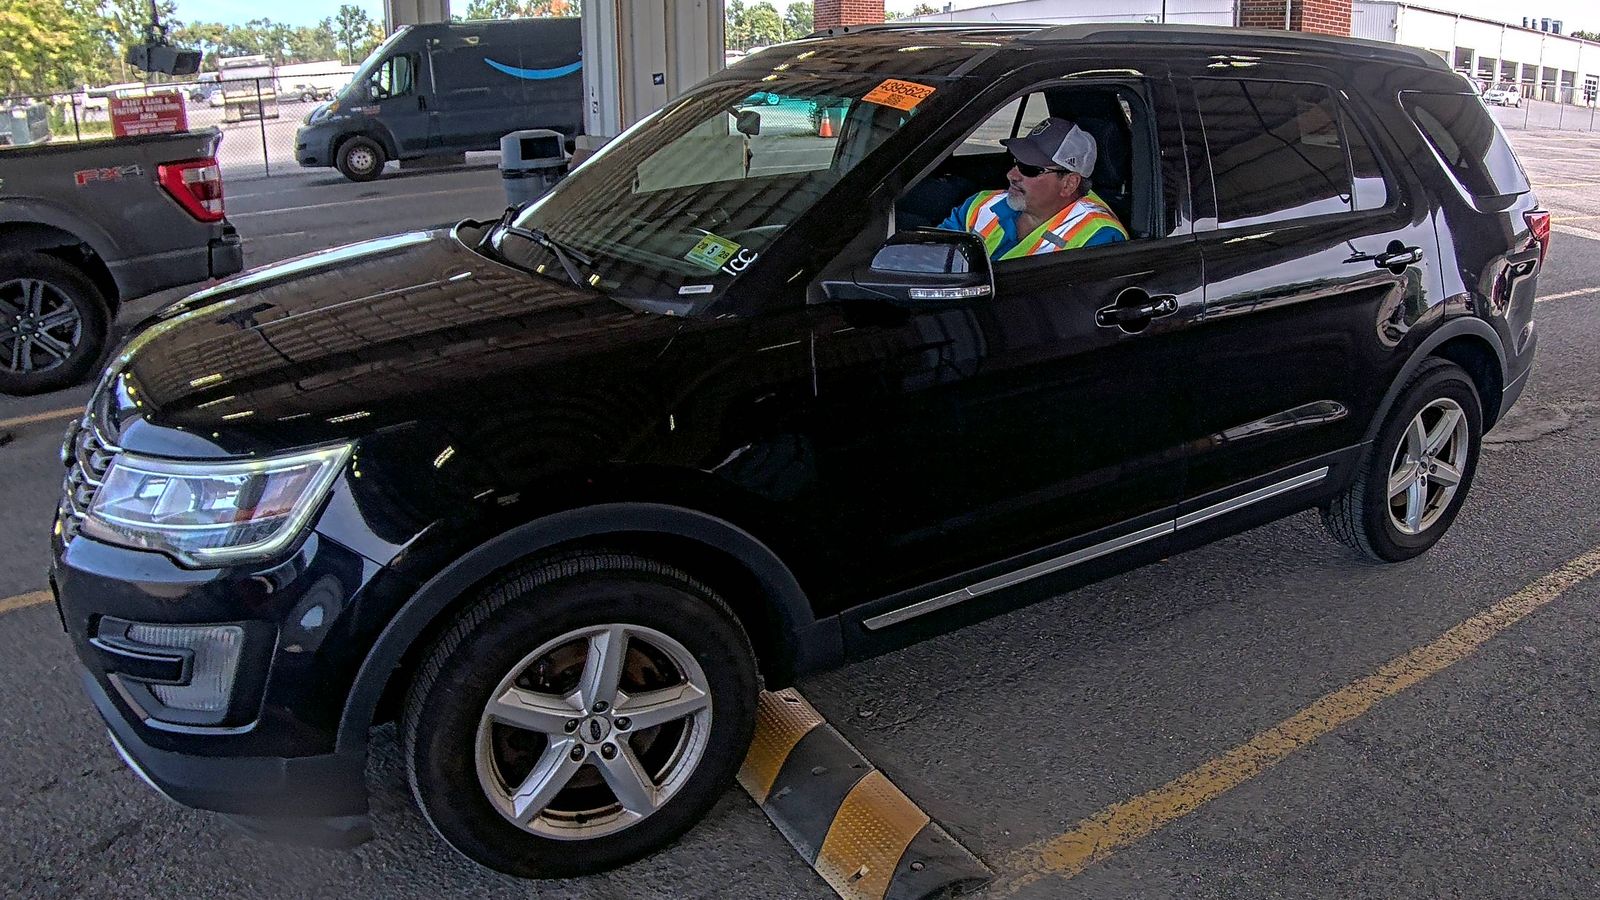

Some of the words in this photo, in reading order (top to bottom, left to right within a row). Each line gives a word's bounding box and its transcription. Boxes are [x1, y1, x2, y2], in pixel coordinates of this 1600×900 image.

[880, 82, 931, 98] 4395623
[74, 164, 144, 185] FX4
[707, 245, 718, 255] 5
